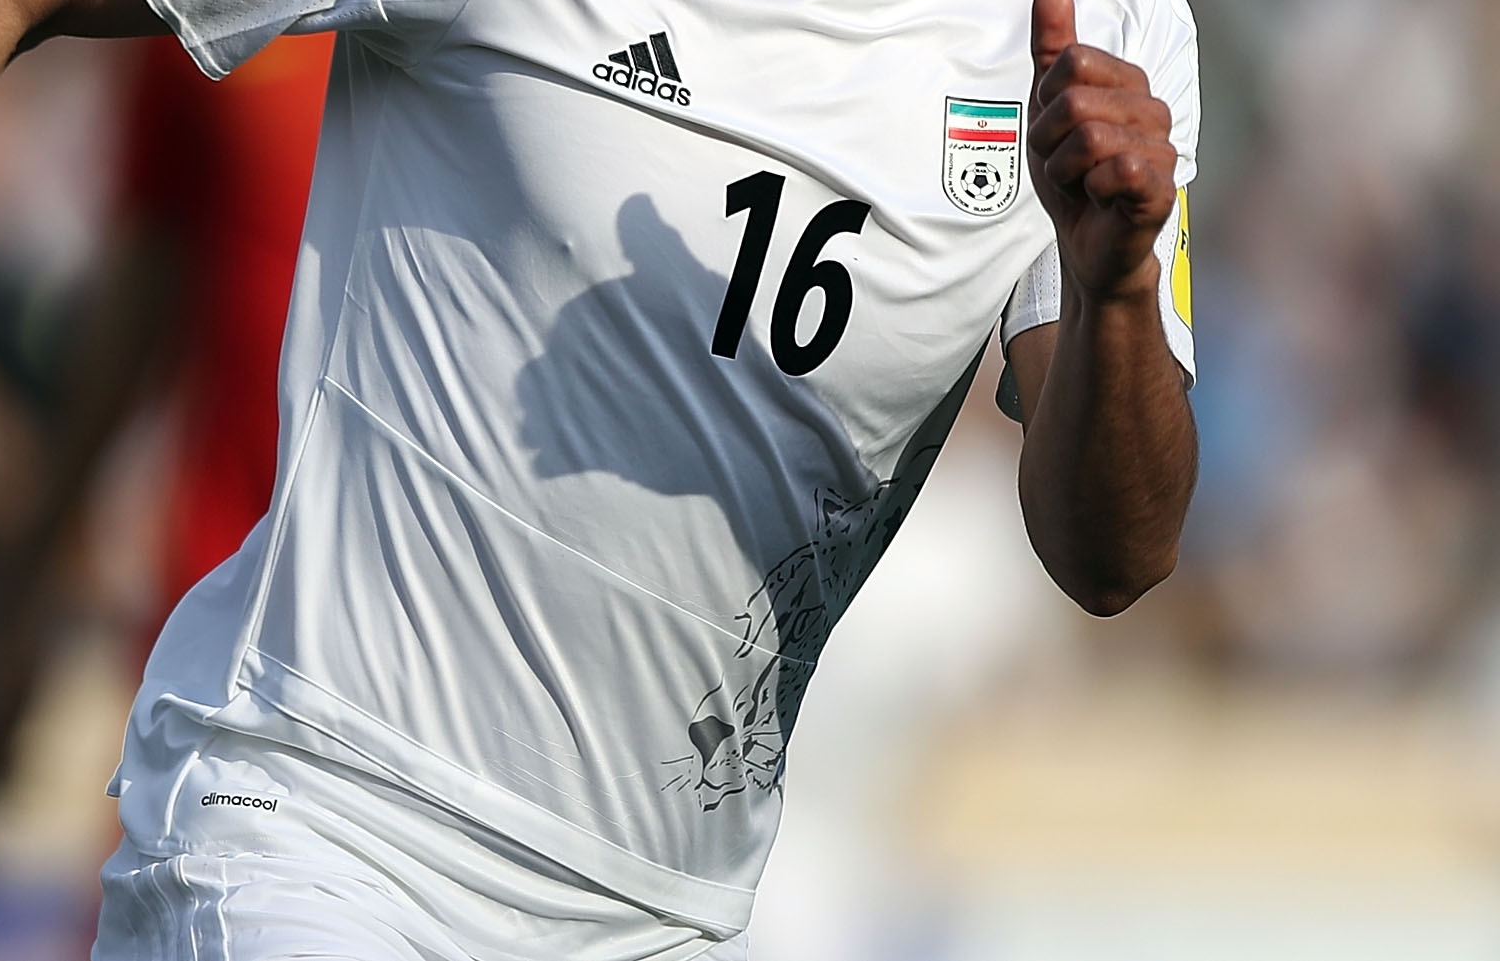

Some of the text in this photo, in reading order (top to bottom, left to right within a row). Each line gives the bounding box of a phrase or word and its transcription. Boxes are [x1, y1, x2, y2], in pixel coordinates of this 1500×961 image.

[592, 63, 691, 106] adidas
[711, 170, 871, 376] 16
[201, 792, 278, 812] climacool
